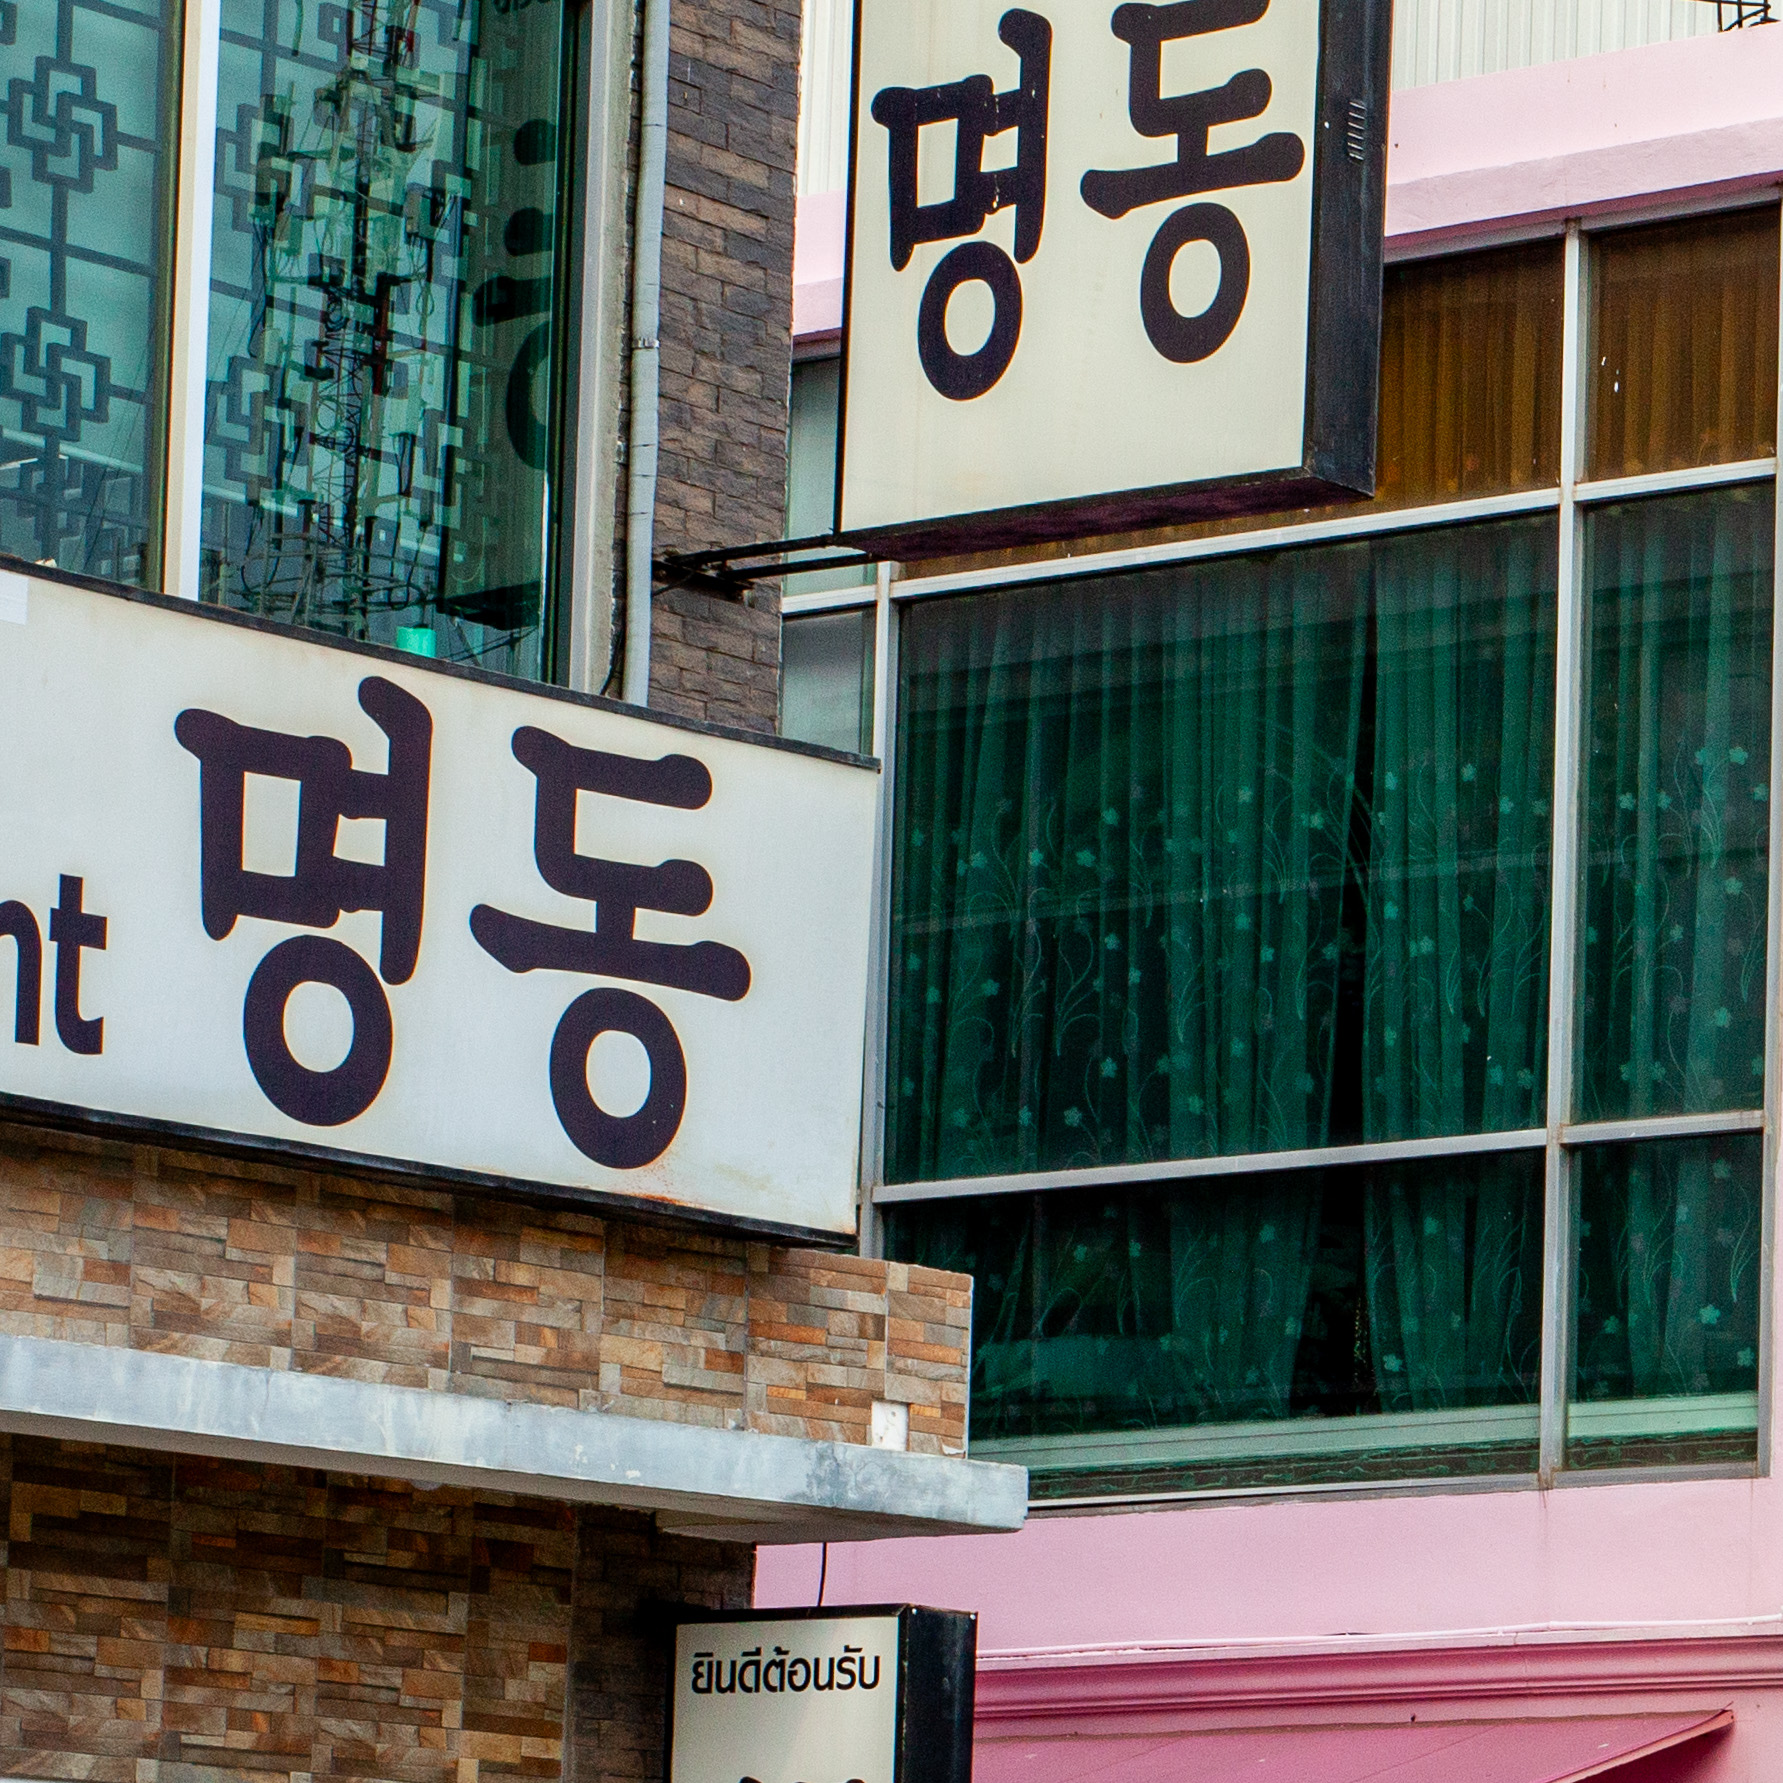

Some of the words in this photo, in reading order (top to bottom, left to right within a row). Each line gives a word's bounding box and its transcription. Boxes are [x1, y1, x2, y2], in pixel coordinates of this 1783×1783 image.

[869, 0, 1306, 401] 명동
[173, 675, 753, 1171] 명동
[690, 1646, 883, 1698] ยินดีต้อนรับ
